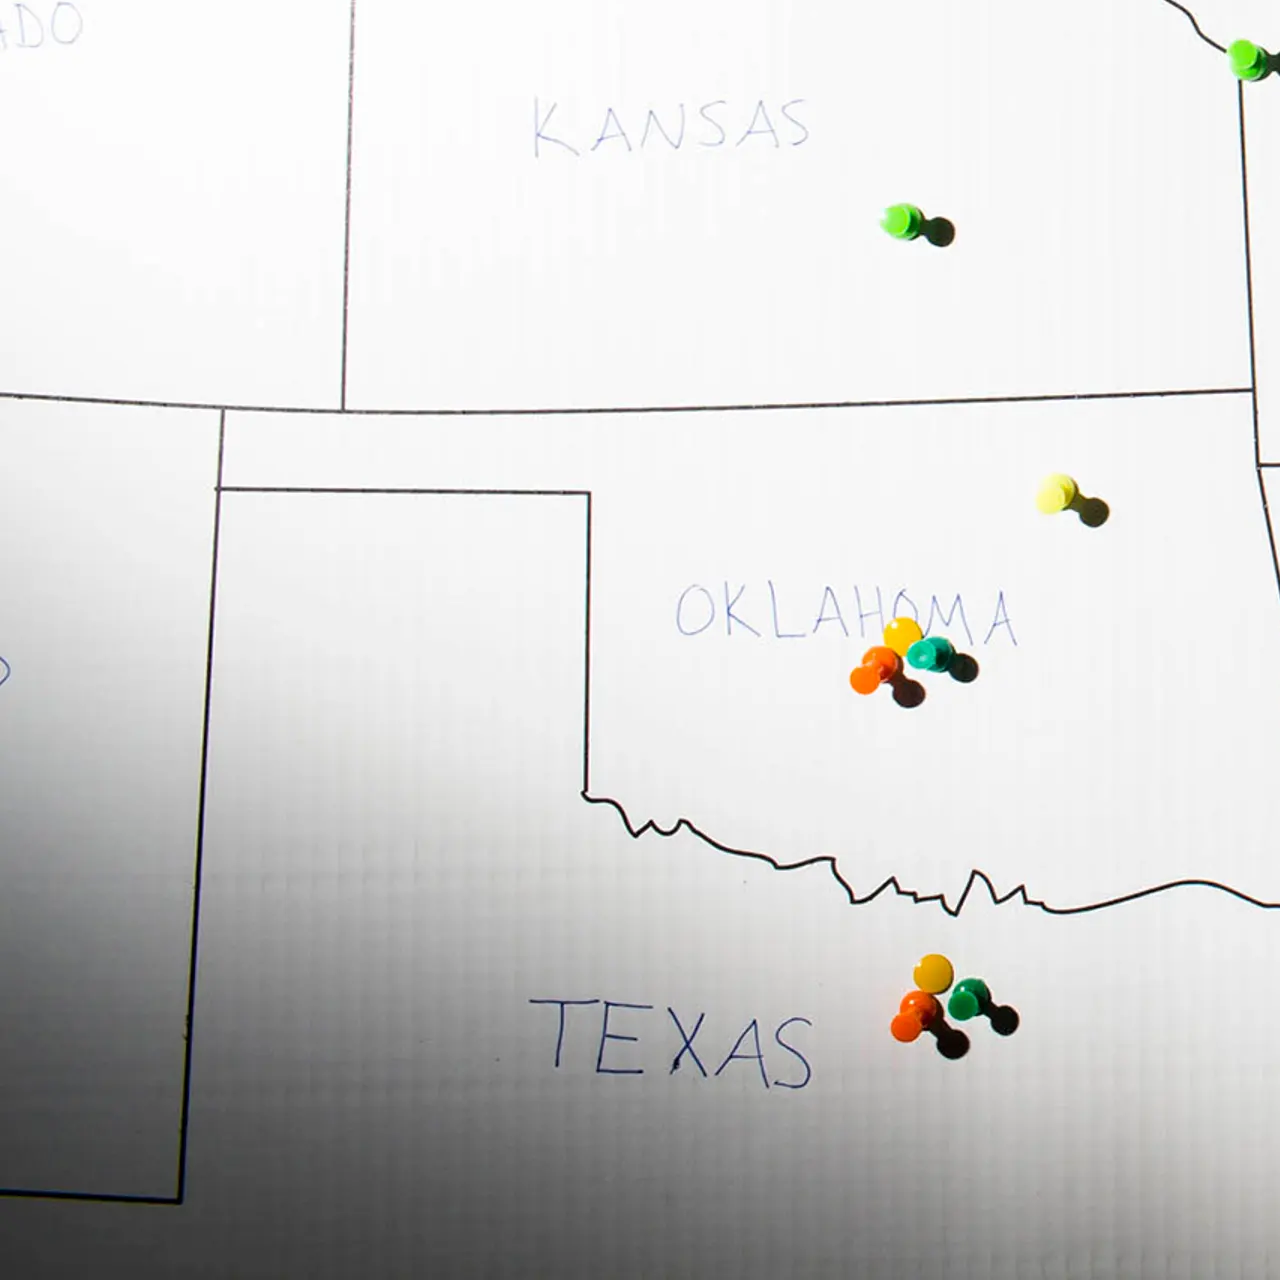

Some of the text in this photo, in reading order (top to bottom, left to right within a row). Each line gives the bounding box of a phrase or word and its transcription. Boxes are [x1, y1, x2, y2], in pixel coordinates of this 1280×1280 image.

[532, 93, 813, 159] KANSAS
[676, 579, 1018, 647] OKLAHOMA
[529, 997, 813, 1090] TEXAS
